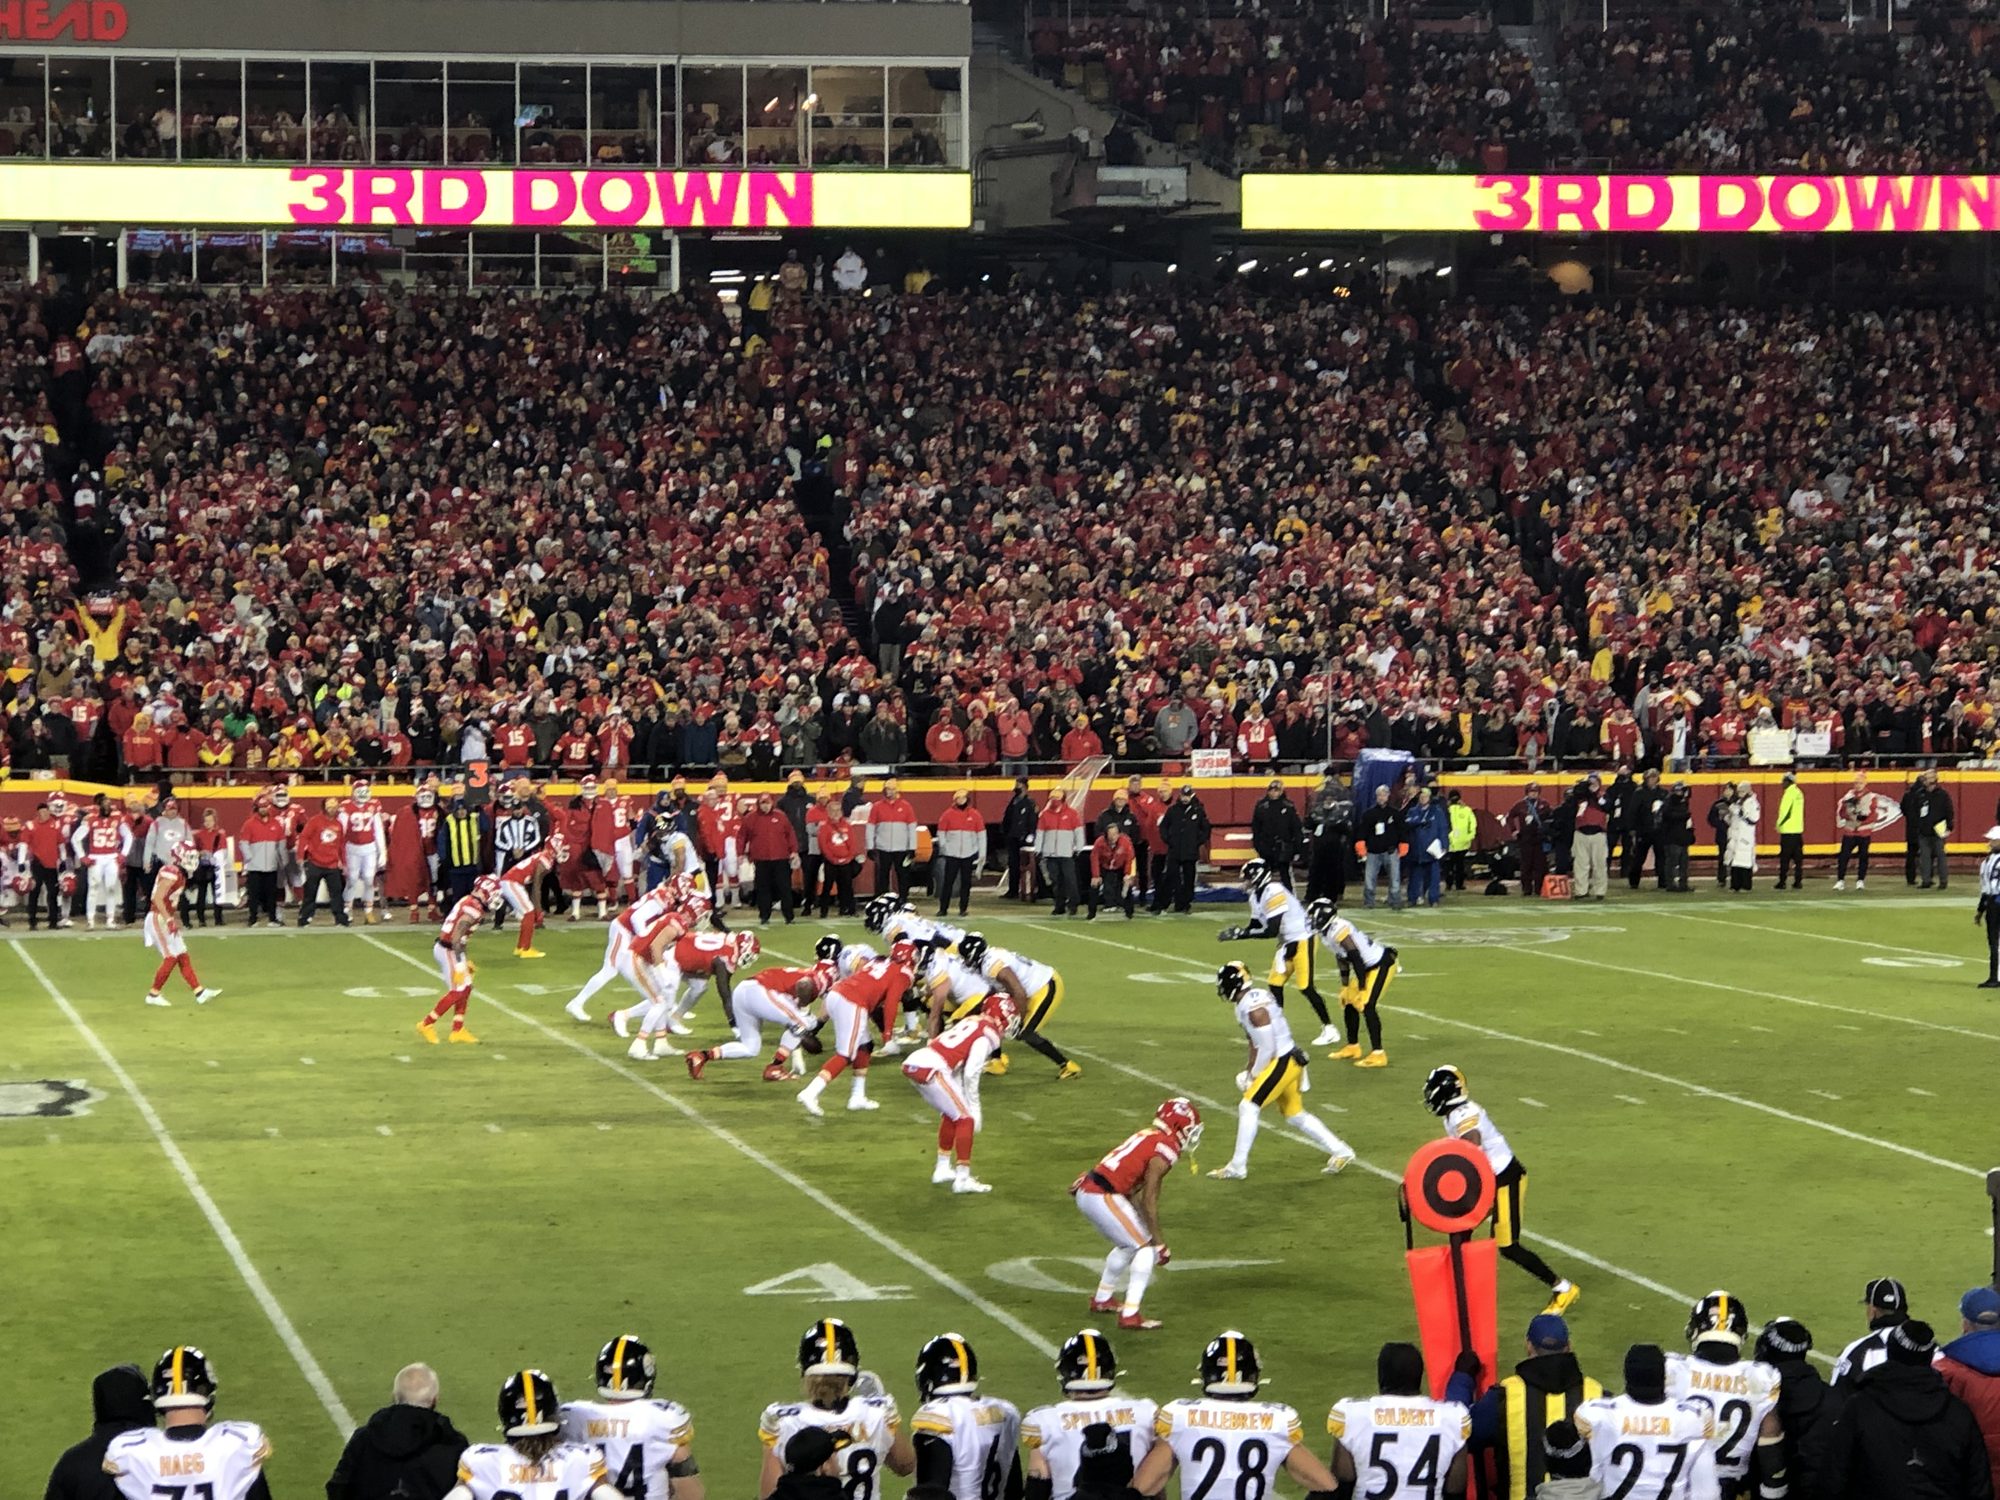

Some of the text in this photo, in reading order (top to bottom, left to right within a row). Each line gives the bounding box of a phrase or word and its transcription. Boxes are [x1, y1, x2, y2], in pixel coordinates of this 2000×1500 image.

[288, 168, 814, 228] 3RD DOWN
[1473, 174, 2000, 233] 3RD DOWN
[55, 346, 71, 362] 15
[72, 706, 87, 722] 15
[508, 730, 524, 746] 15
[569, 742, 586, 759] 15
[468, 762, 488, 788] 3
[93, 828, 118, 847] 53
[1549, 878, 1569, 896] 20
[1690, 1369, 1749, 1395] HARRIS
[1187, 1409, 1275, 1431] KILLEBREW
[1373, 1408, 1435, 1426] GILBERT
[1621, 1415, 1671, 1436] ALLEN
[585, 1418, 631, 1438] WATT
[159, 1453, 206, 1477] HAEG
[509, 1464, 557, 1484] SNELL
[1190, 1438, 1268, 1500] 28
[1365, 1433, 1440, 1500] 54
[1609, 1443, 1689, 1500] 27
